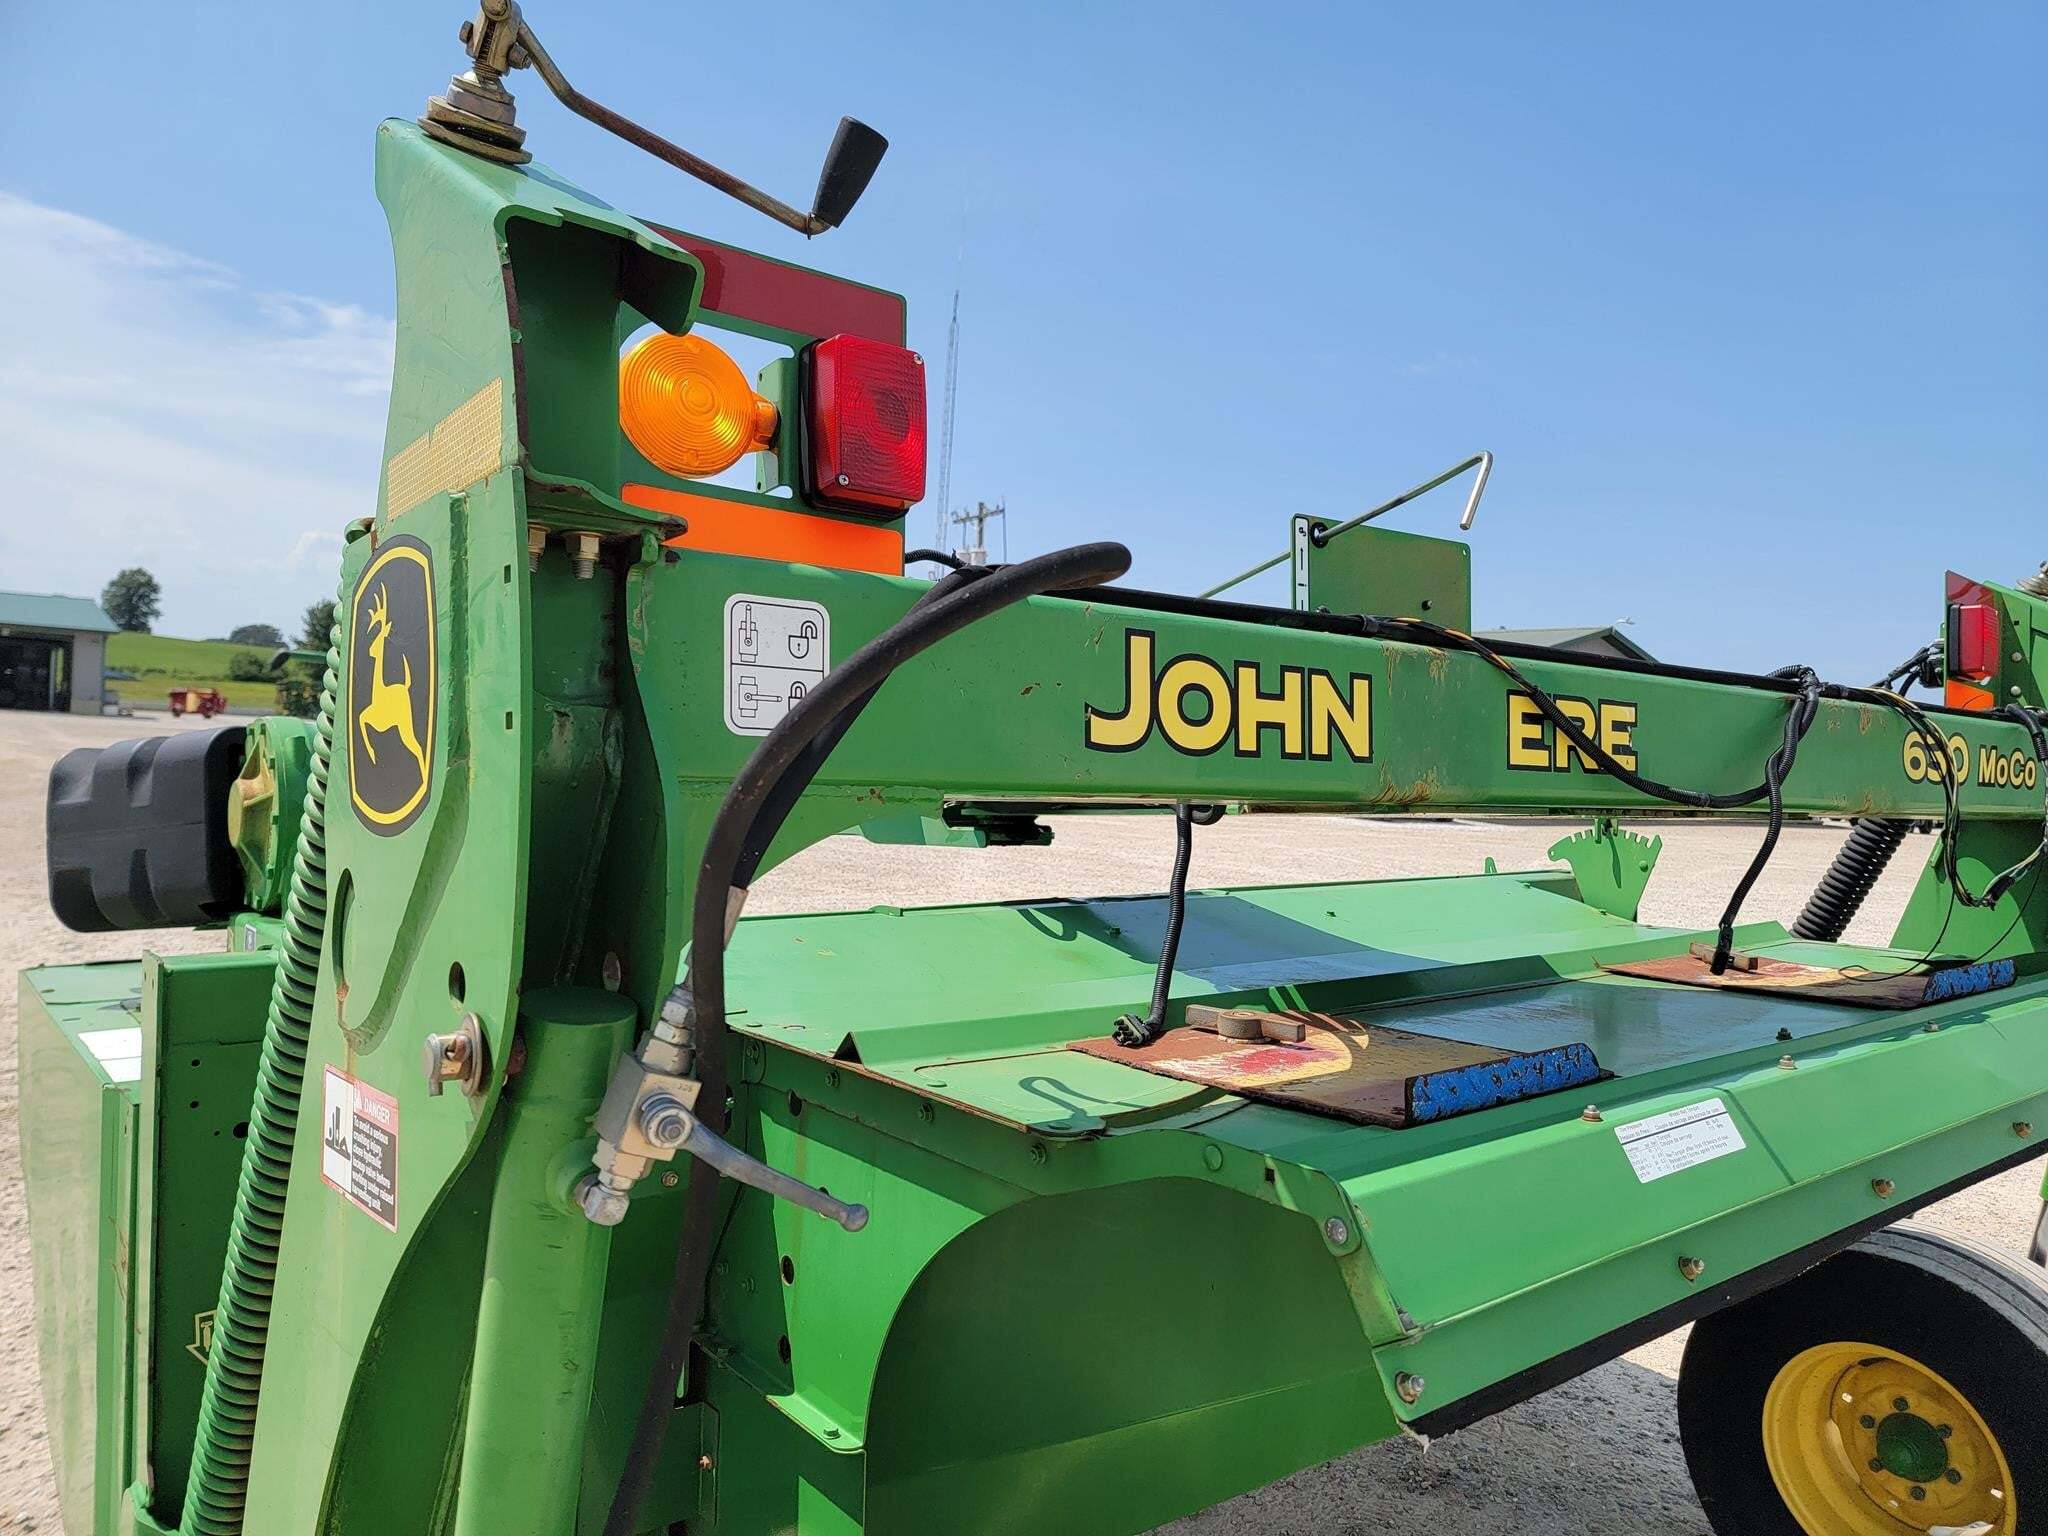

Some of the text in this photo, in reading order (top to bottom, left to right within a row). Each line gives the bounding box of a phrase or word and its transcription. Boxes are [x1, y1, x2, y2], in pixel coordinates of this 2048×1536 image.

[1085, 627, 1638, 775] JOHN ERE
[1977, 744, 2037, 790] MoCo
[364, 1095, 391, 1126] DANGER
